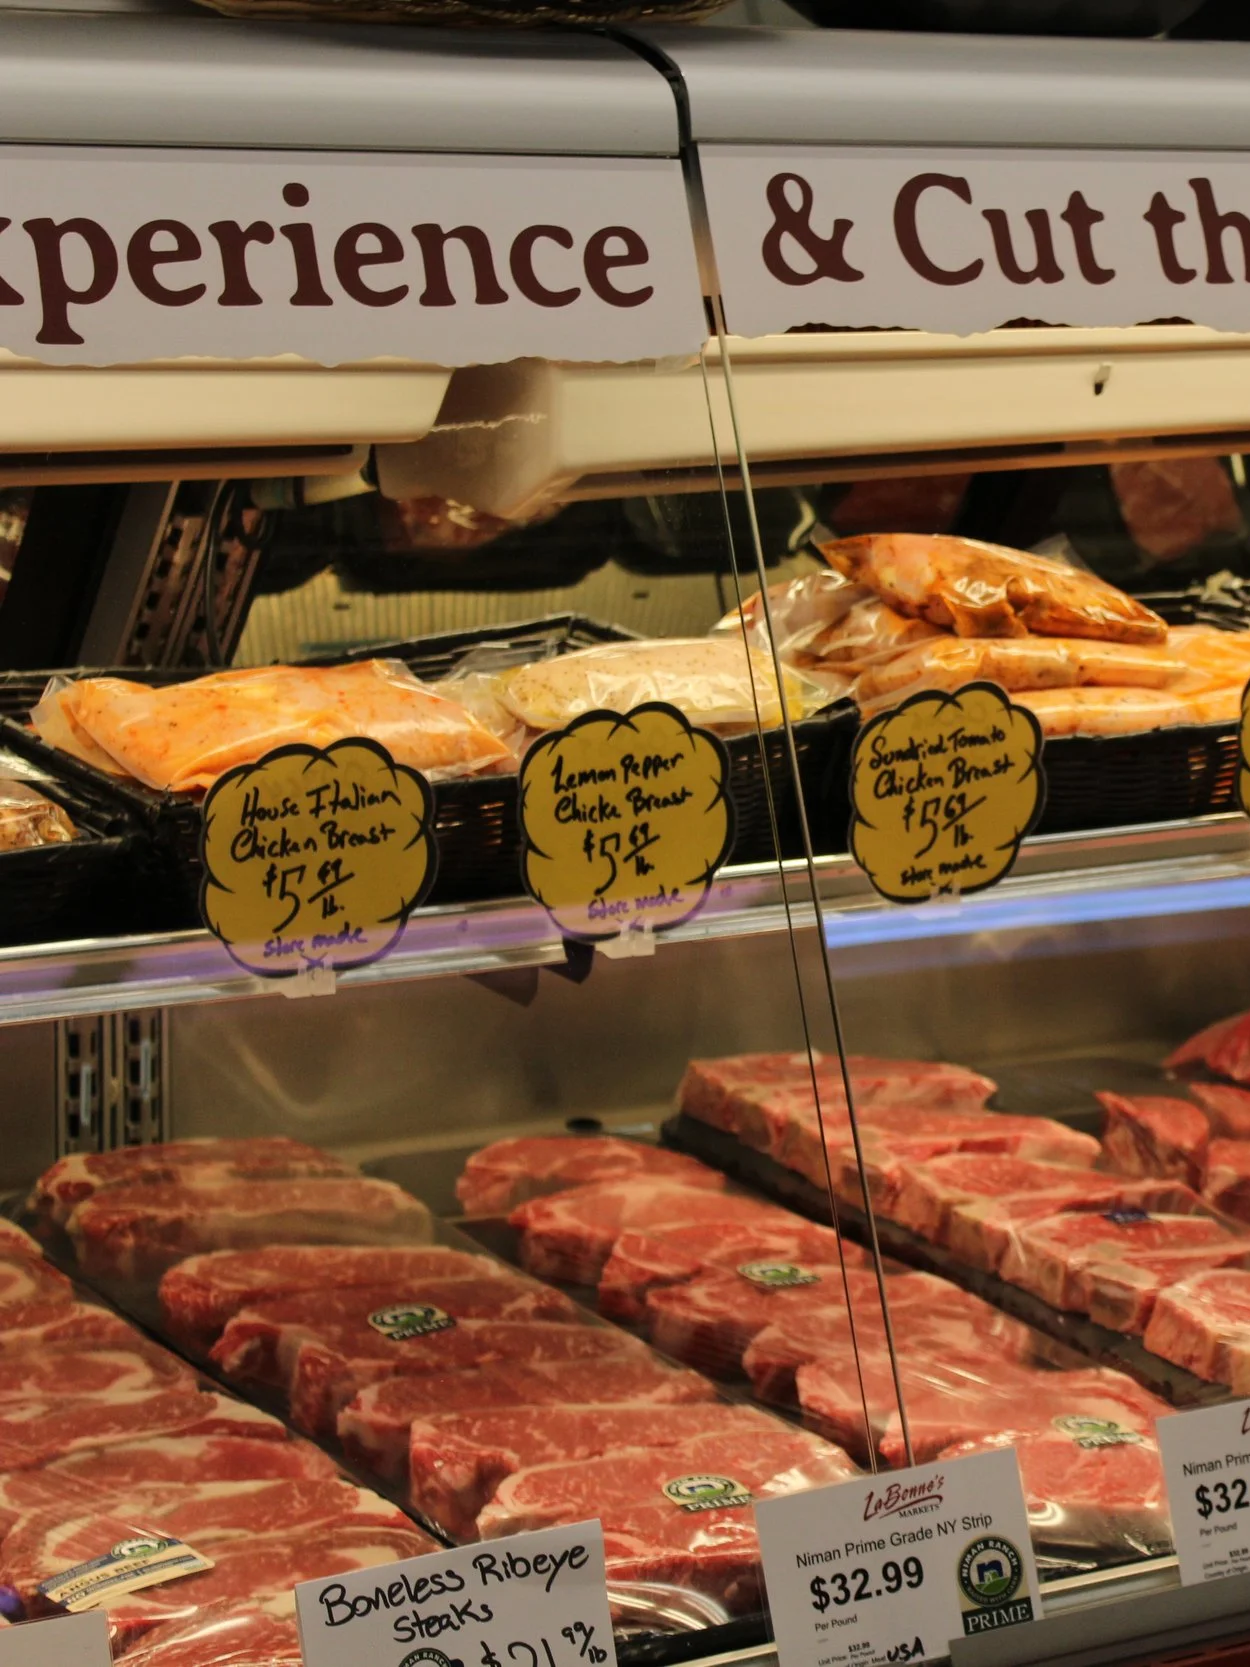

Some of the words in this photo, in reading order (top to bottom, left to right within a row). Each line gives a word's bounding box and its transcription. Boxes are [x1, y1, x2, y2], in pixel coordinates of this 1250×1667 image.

[762, 172, 864, 286] &
[893, 172, 1116, 286] Cut
[550, 754, 617, 794] Lemon
[620, 753, 685, 784] Pepper
[241, 786, 300, 827] House
[305, 778, 402, 818] Italian
[230, 827, 318, 863] Chicken
[319, 821, 396, 850] Breast
[1181, 1460, 1223, 1478] Niman
[685, 1493, 751, 1512] PRIME
[864, 1474, 945, 1521] LaBonne's
[898, 1503, 941, 1519] MARKETS
[796, 1549, 841, 1569] Niman
[844, 1538, 886, 1558] Prime
[890, 1528, 933, 1547] Grade
[937, 1520, 958, 1537] NY
[962, 1512, 993, 1532] Strip
[1199, 1526, 1213, 1538] Per
[1213, 1521, 1238, 1534] Pound
[962, 1542, 985, 1578] NIMAN
[988, 1540, 1019, 1567] RANCH
[319, 1568, 466, 1627] Boneless
[472, 1544, 590, 1593] Ribeye
[809, 1555, 925, 1613] $32.99
[393, 1598, 494, 1643] Steaks
[814, 1620, 830, 1632] Per
[831, 1613, 858, 1630] Pound
[966, 1603, 1030, 1633] PRIME
[886, 1635, 925, 1663] USA
